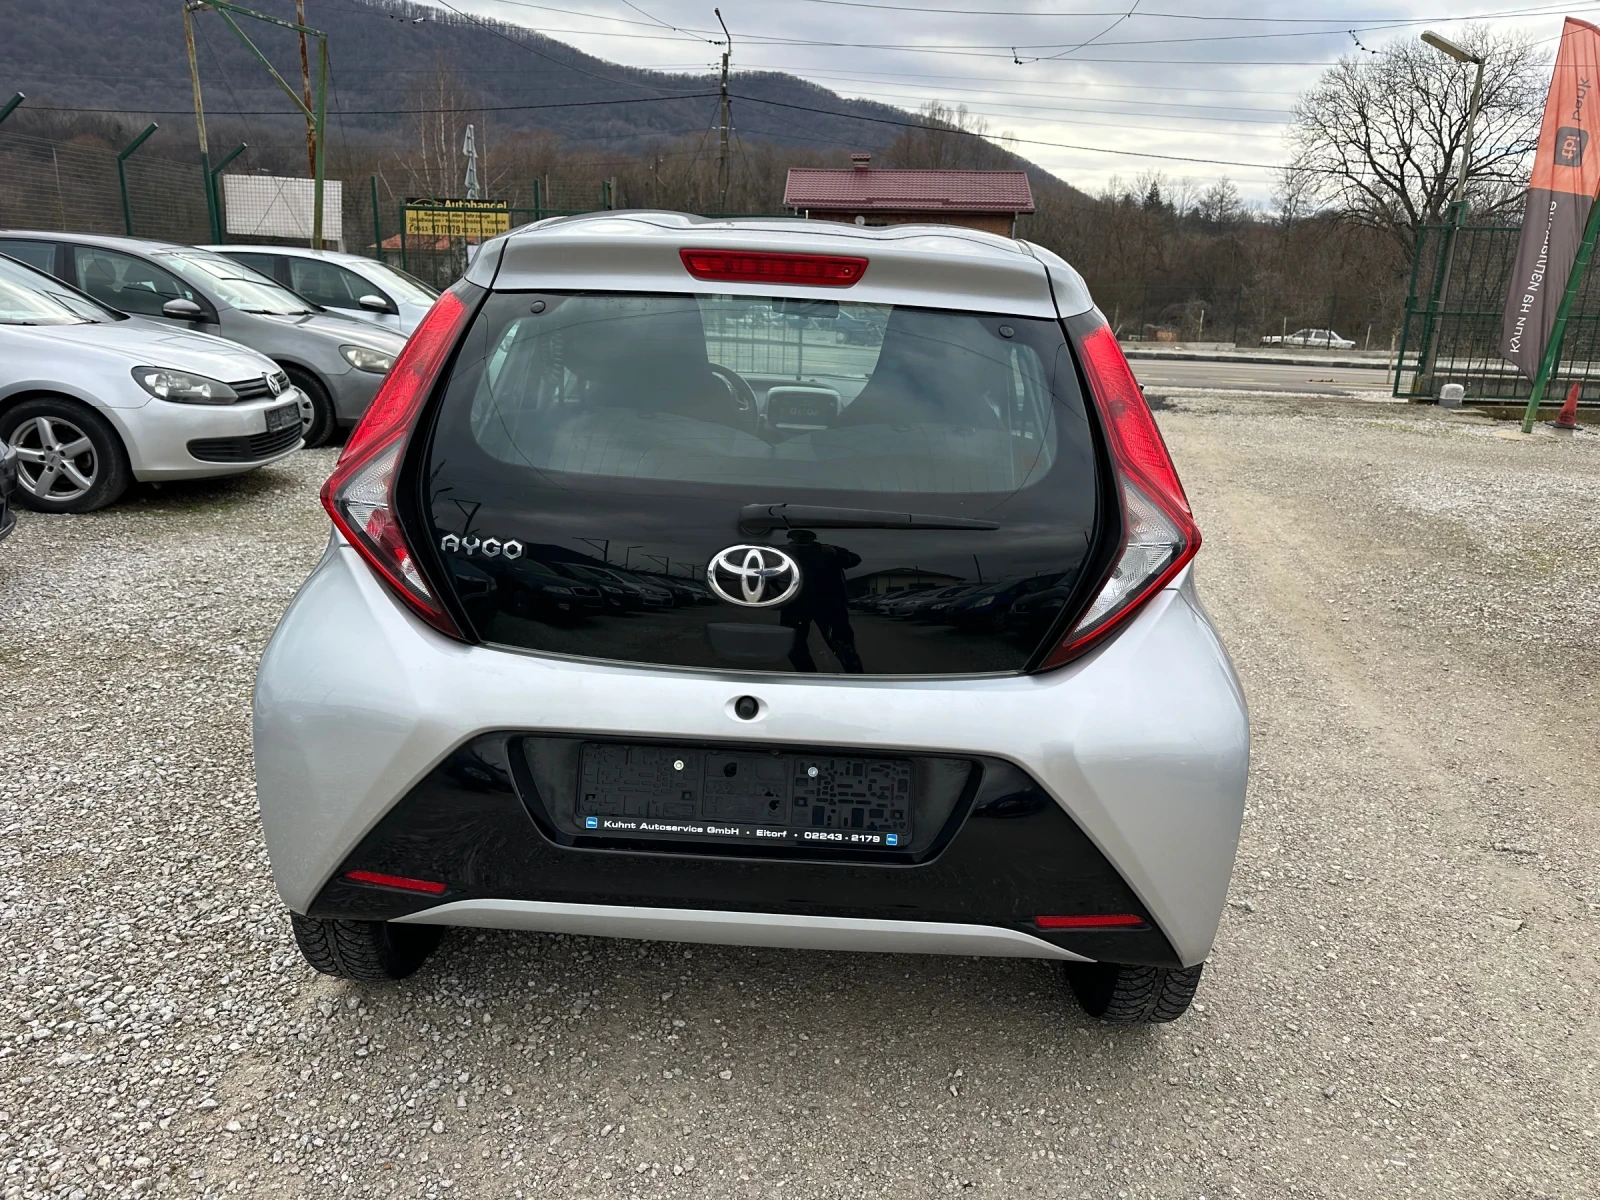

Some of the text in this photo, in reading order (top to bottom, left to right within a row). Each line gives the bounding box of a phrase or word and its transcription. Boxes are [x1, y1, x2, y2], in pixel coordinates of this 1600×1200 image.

[441, 533, 523, 560] AYGO
[603, 820, 636, 830] Kuhnt
[639, 822, 703, 834] Autoservice
[706, 826, 740, 836] GmbH
[756, 829, 788, 838] Eitorf
[804, 831, 843, 841] 02243
[851, 834, 881, 843] 2179
